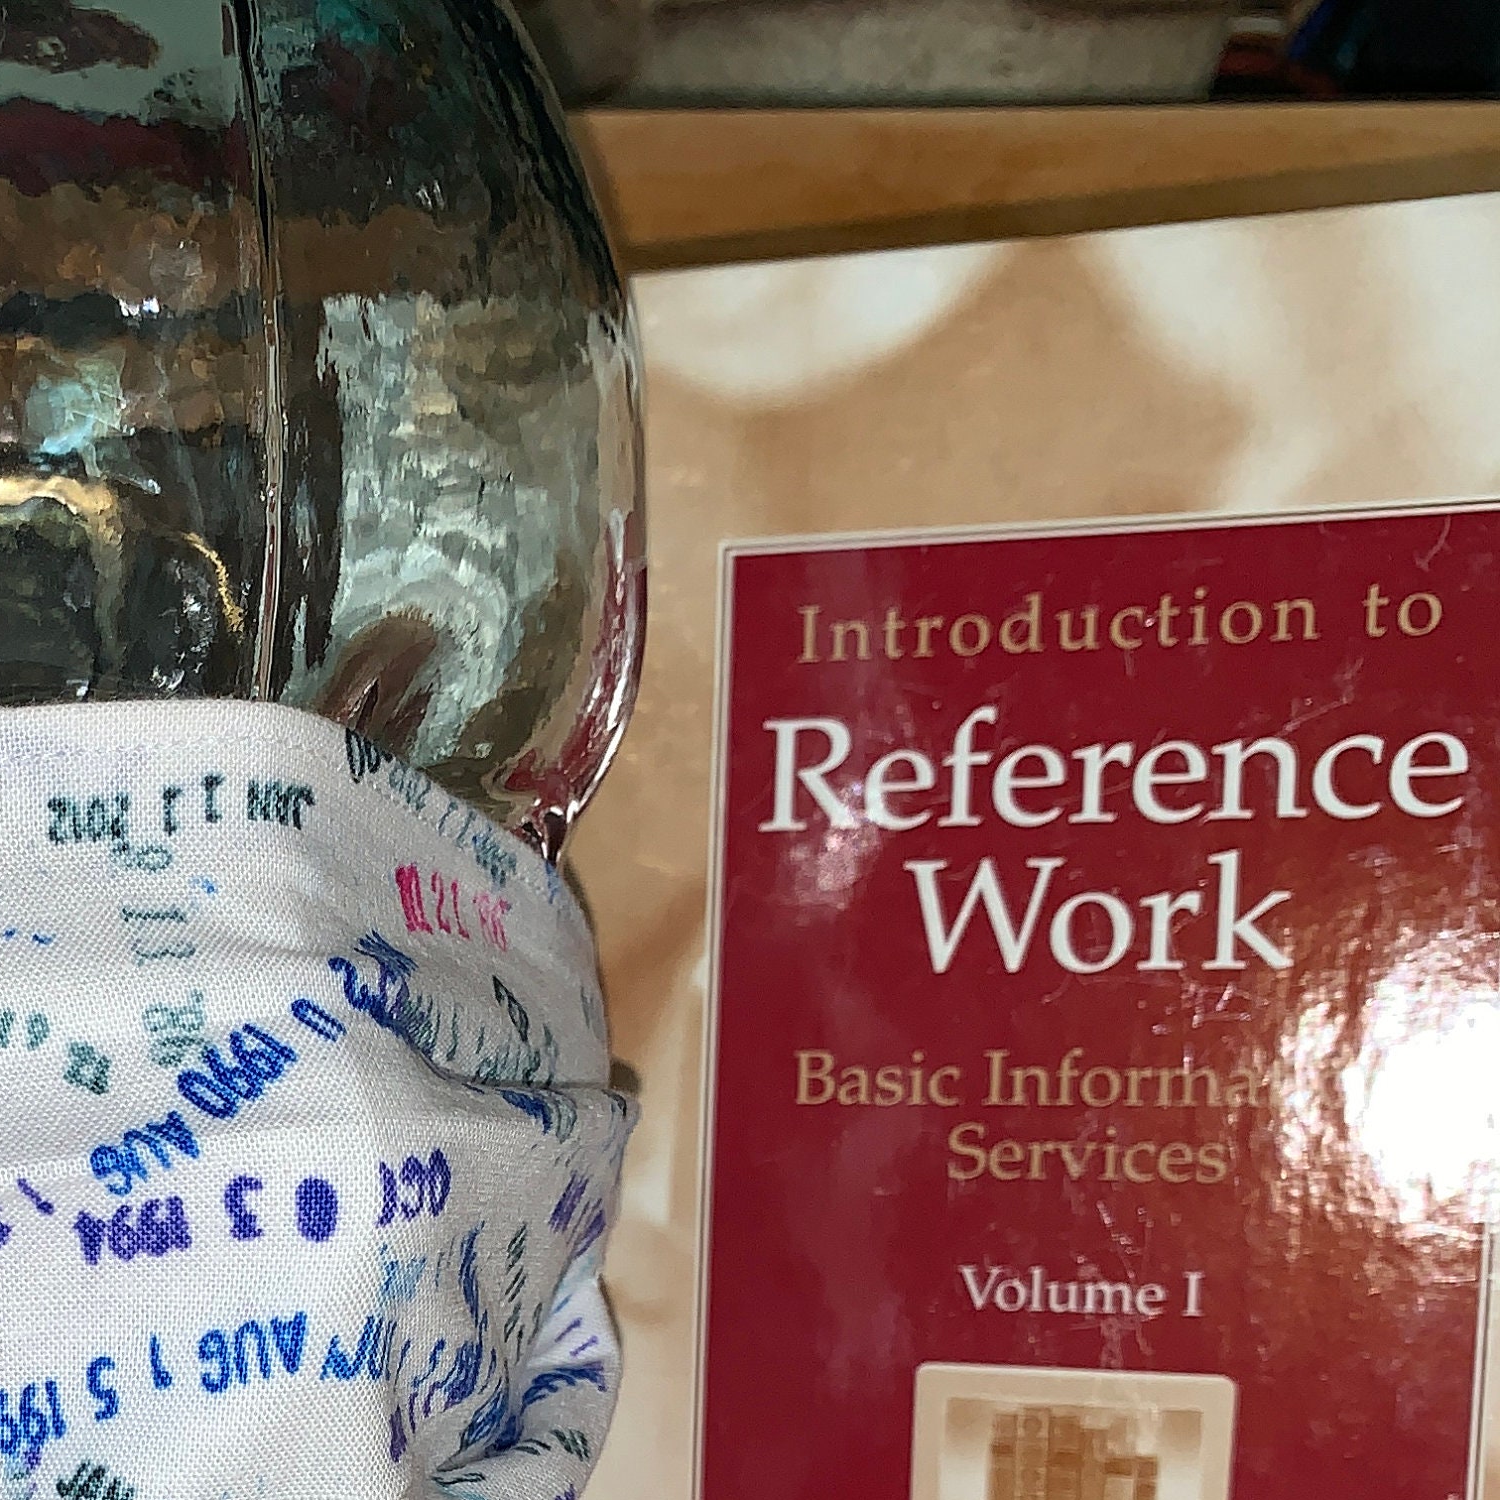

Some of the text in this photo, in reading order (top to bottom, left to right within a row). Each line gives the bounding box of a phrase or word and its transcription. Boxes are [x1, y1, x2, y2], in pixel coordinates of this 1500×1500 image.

[796, 582, 1444, 666] Introduction to
[758, 704, 1471, 834] Reference
[903, 848, 1296, 977] Work
[793, 1044, 1285, 1110] Basic Informa
[946, 1122, 1231, 1184] Services
[958, 1265, 1205, 1319] Volume I
[198, 1312, 307, 1394] AUG
